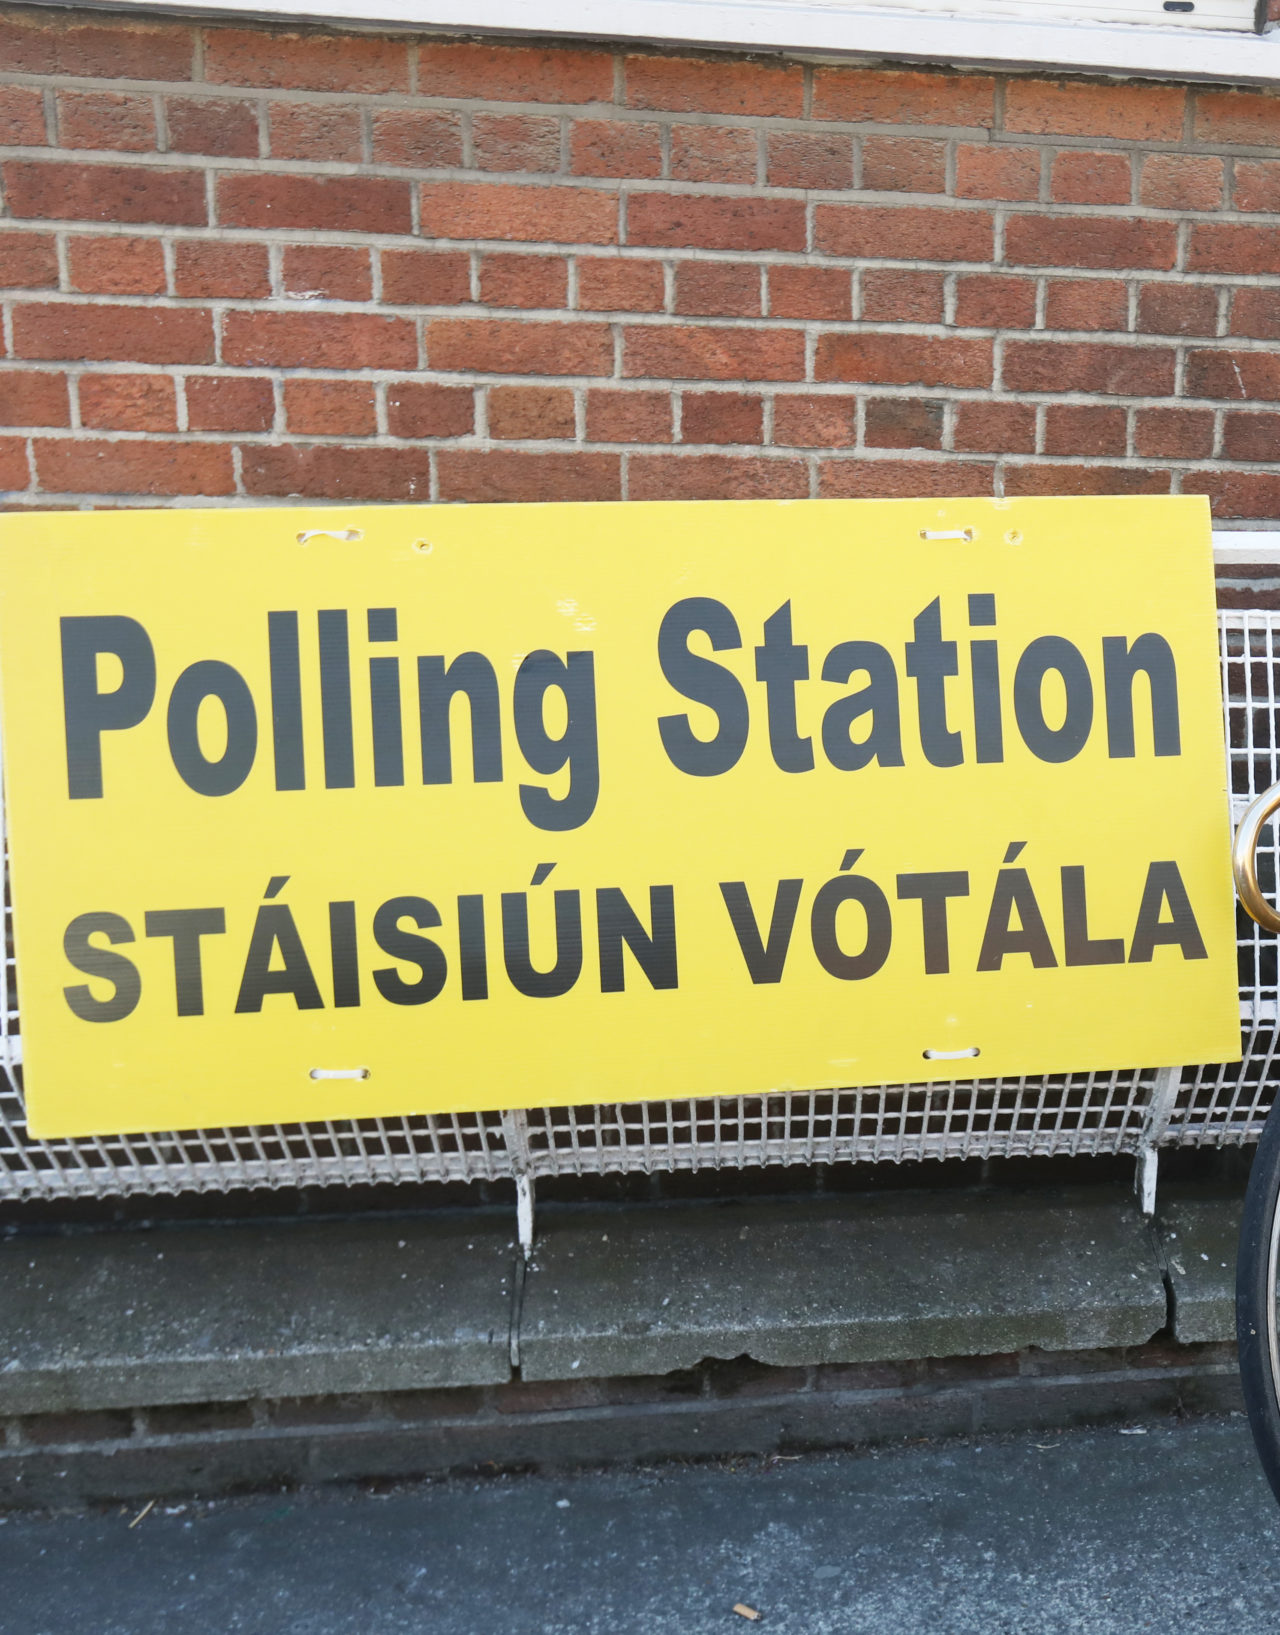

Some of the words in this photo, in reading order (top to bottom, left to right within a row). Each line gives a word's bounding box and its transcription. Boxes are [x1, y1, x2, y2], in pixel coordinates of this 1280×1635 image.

[60, 607, 600, 833] Polling
[657, 593, 1182, 777] Station
[62, 862, 679, 1024] STÁISIÚN
[718, 841, 1209, 986] VÓTÁLA
